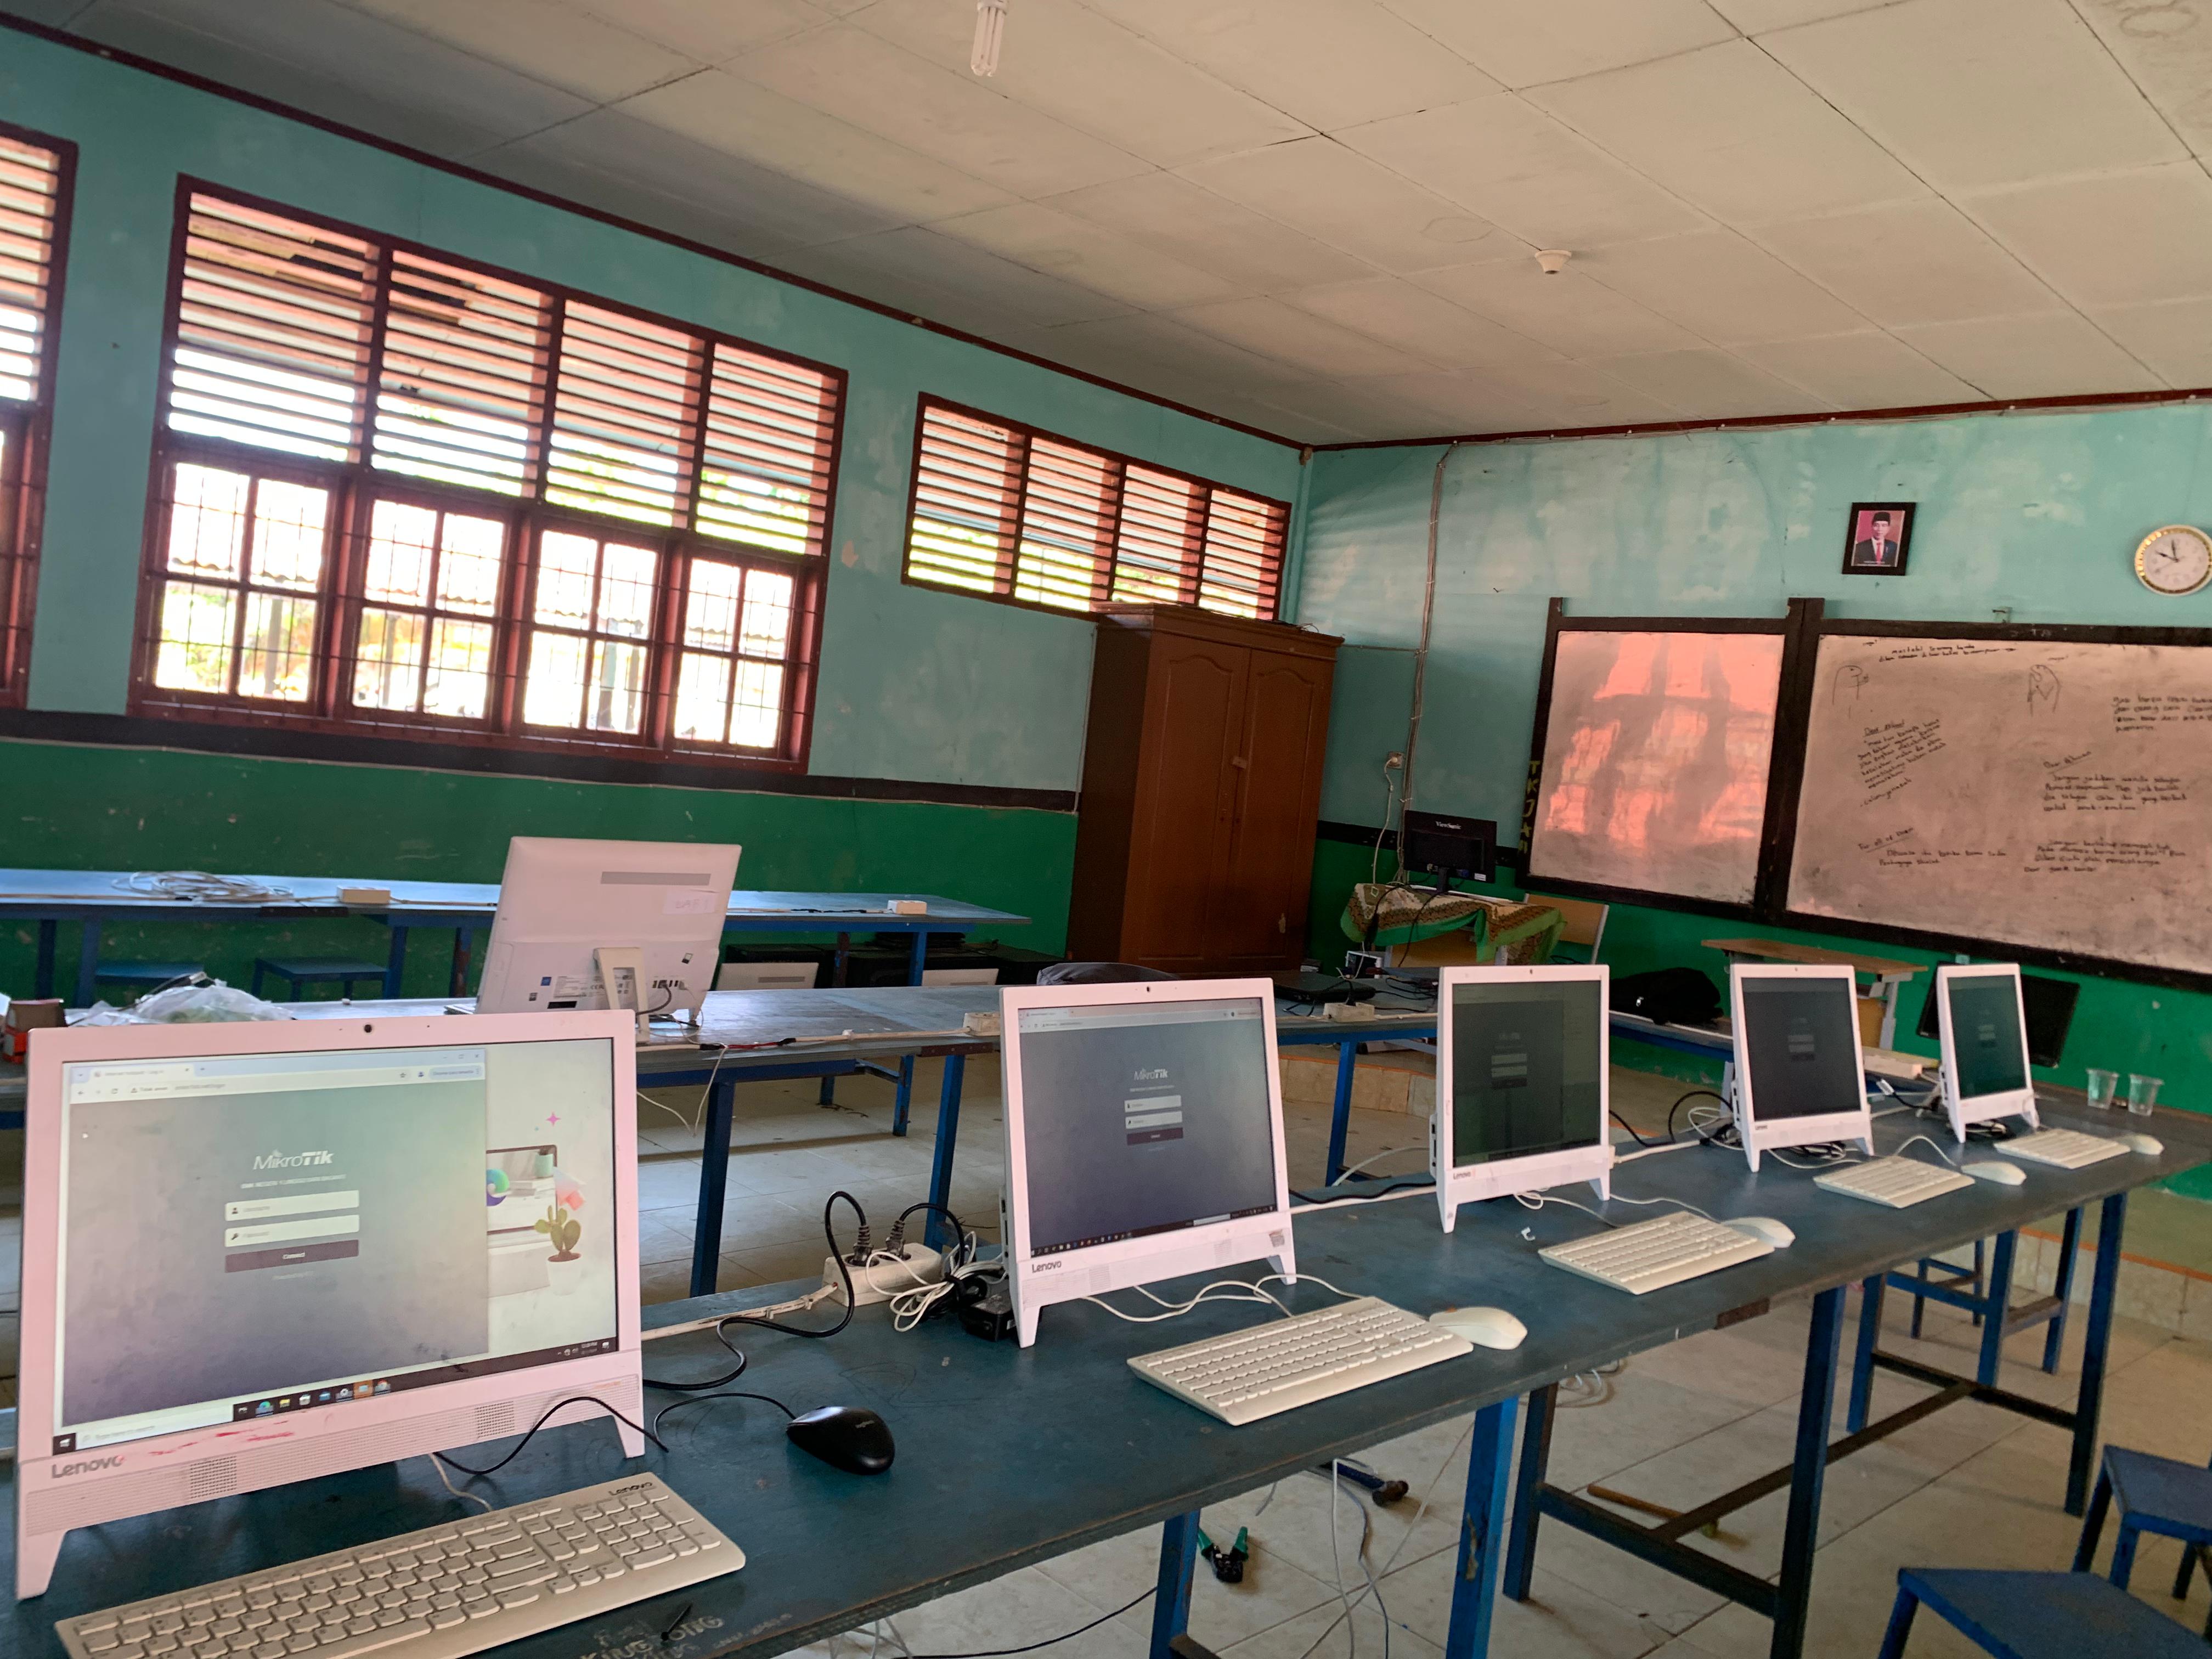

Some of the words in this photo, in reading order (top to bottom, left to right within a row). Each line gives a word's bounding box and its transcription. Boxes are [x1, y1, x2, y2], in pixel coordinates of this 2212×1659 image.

[252, 1150, 336, 1170] MikroTik
[1032, 1261, 1062, 1273] Lenovo
[608, 1482, 652, 1496] Lenovo
